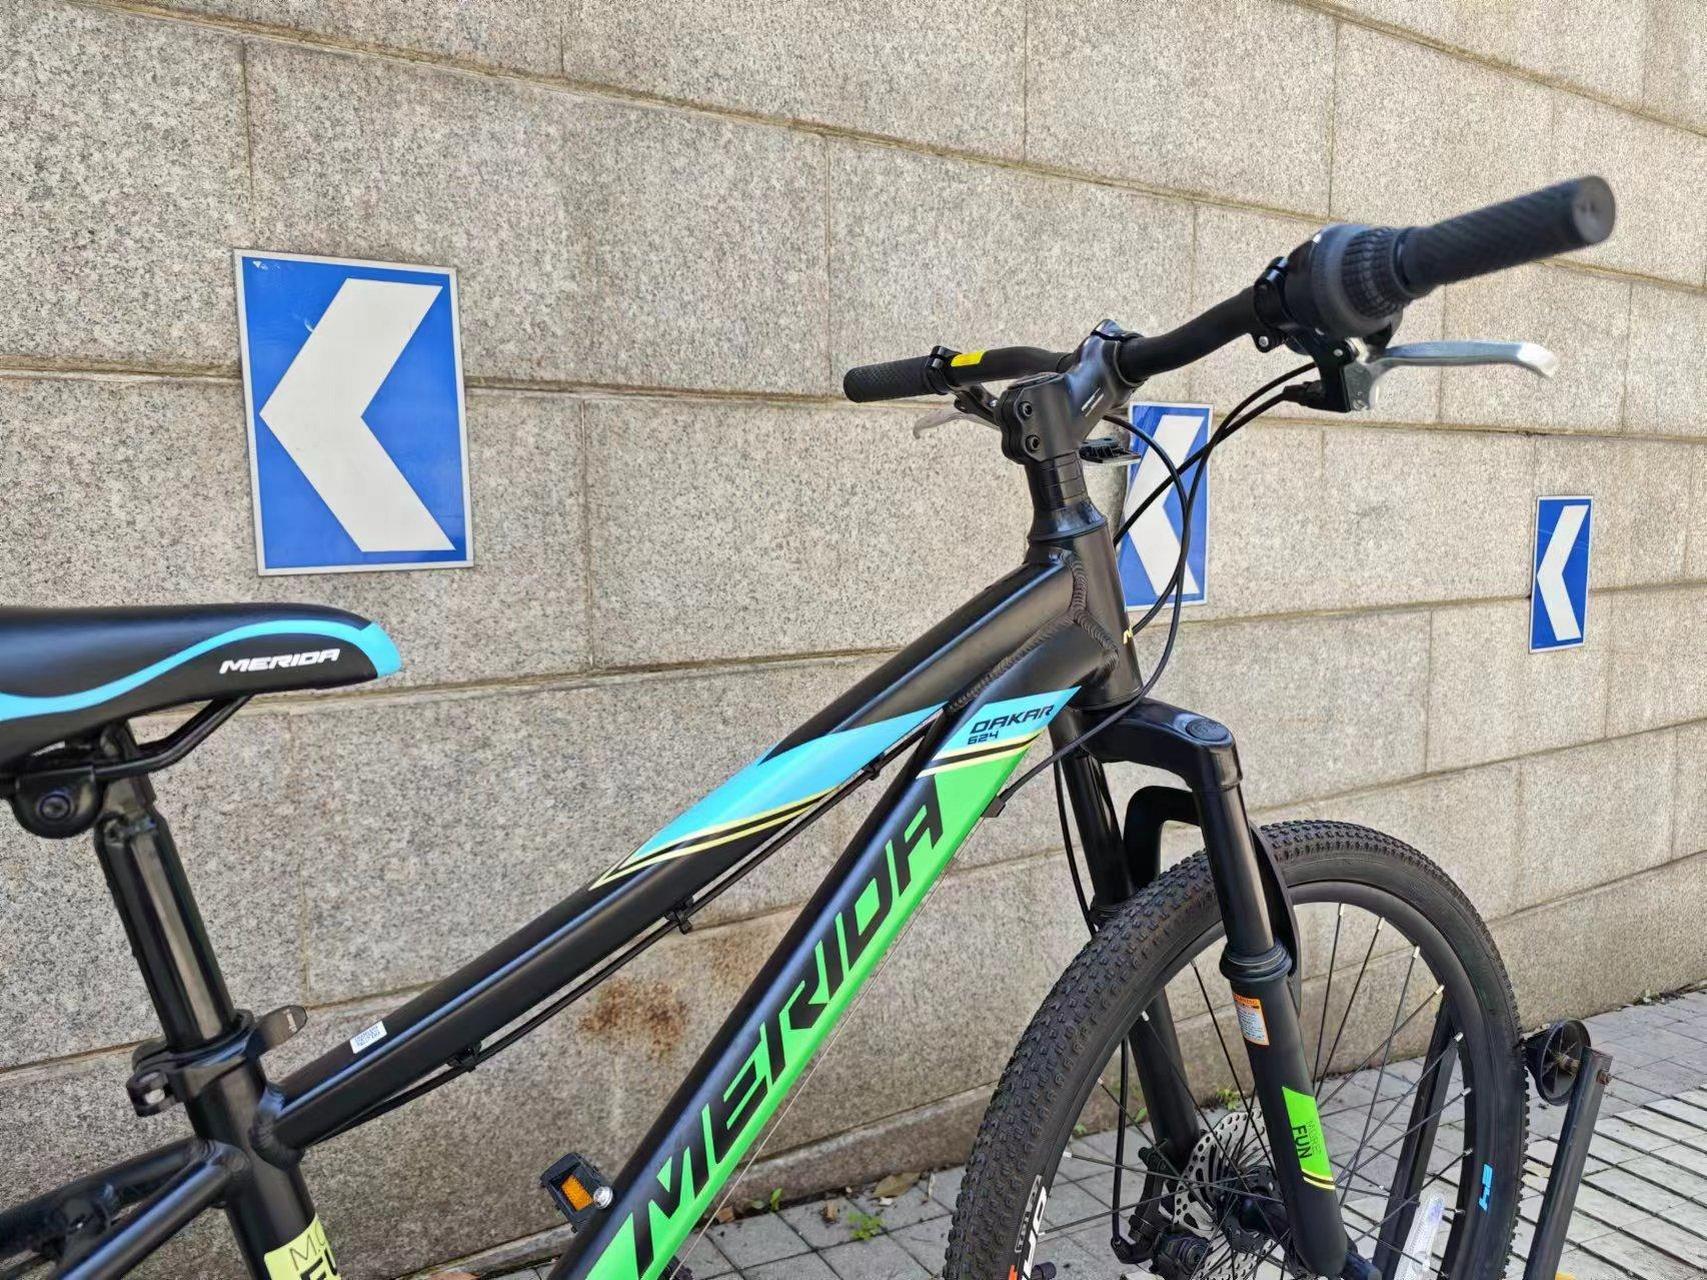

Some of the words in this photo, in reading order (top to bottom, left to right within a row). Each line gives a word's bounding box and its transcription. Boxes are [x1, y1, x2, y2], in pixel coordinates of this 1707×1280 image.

[219, 648, 341, 674] MERIDA
[970, 705, 1054, 734] DAKAR
[968, 731, 999, 745] 624
[631, 774, 944, 1276] MERIDA
[1293, 1125, 1313, 1159] FUN
